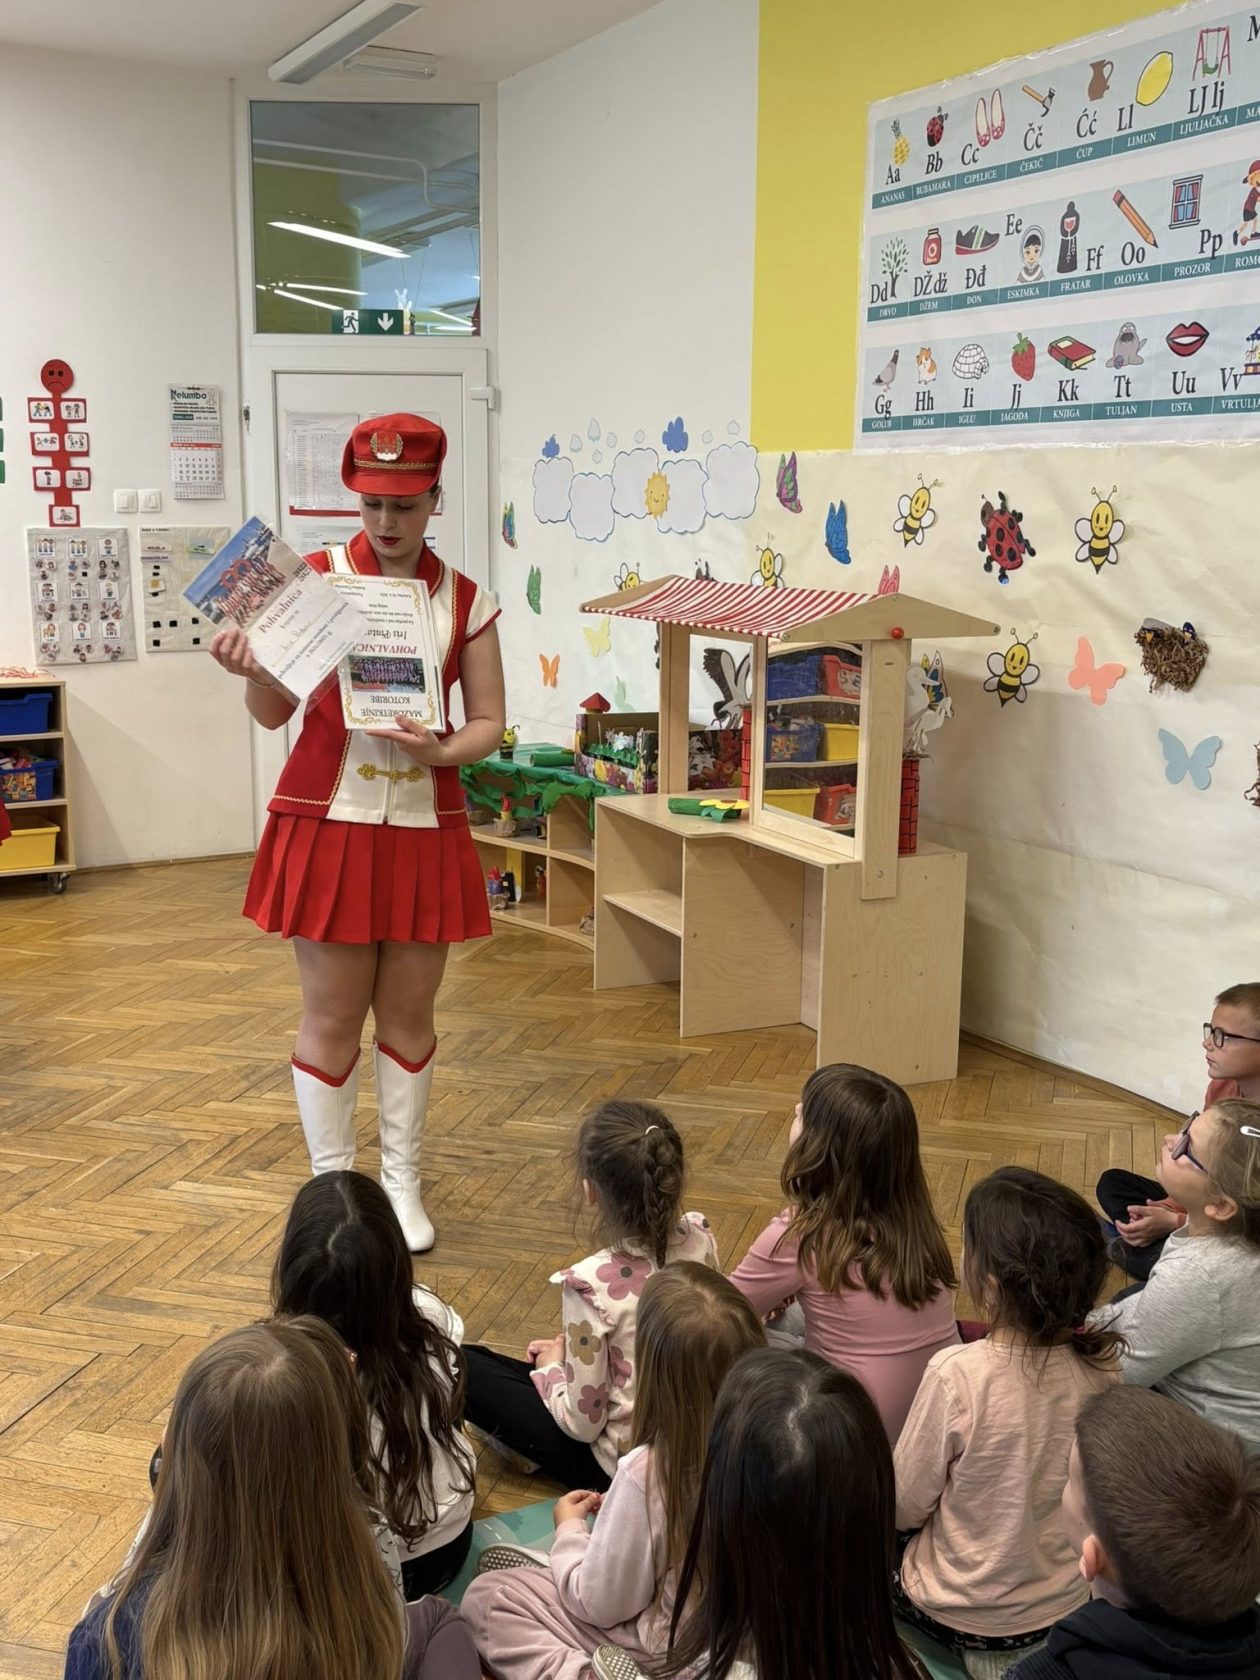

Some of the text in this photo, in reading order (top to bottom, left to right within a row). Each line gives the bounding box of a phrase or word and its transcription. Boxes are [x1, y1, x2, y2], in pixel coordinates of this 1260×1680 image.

[1187, 81, 1225, 117] LJ lj
[1116, 104, 1134, 132] Ll
[1179, 113, 1229, 135] LJULJAČKA
[1023, 122, 1043, 151] Čč
[1127, 131, 1157, 147] LIMUN
[925, 151, 943, 175] Bb
[961, 143, 979, 166] Cc
[885, 164, 901, 185] Aa
[964, 171, 997, 185] CIPELICE
[880, 190, 905, 204] ANANAS
[1005, 213, 1023, 236] Ee
[1121, 241, 1146, 266] Oo
[1198, 228, 1223, 260] Pp
[1085, 245, 1104, 271] Ff
[1174, 262, 1211, 277] PROZOR
[913, 270, 948, 297] DŽ dž
[965, 264, 986, 290] Đđ
[1060, 279, 1091, 292] FRATAR
[1114, 271, 1149, 286] OLOVKA
[870, 281, 888, 304] Dd
[1007, 287, 1040, 299] ESKIMKA
[879, 307, 896, 317] DRVO
[1057, 378, 1080, 402] Kk
[1113, 375, 1132, 398] Tt
[1171, 370, 1196, 395] Uu
[1219, 367, 1243, 392] Vv
[874, 394, 892, 420] Gg
[915, 390, 935, 412] Hh
[962, 387, 974, 408] Ii
[1010, 383, 1022, 411] Jj
[1171, 401, 1193, 413] USTA
[958, 414, 976, 424] IGLU
[1001, 411, 1029, 422] JAGODA
[1053, 408, 1080, 419] KNJIGA
[1105, 404, 1138, 416] TULJAN
[258, 589, 303, 633] Pohvalnica
[370, 695, 411, 705] KOTORIBE
